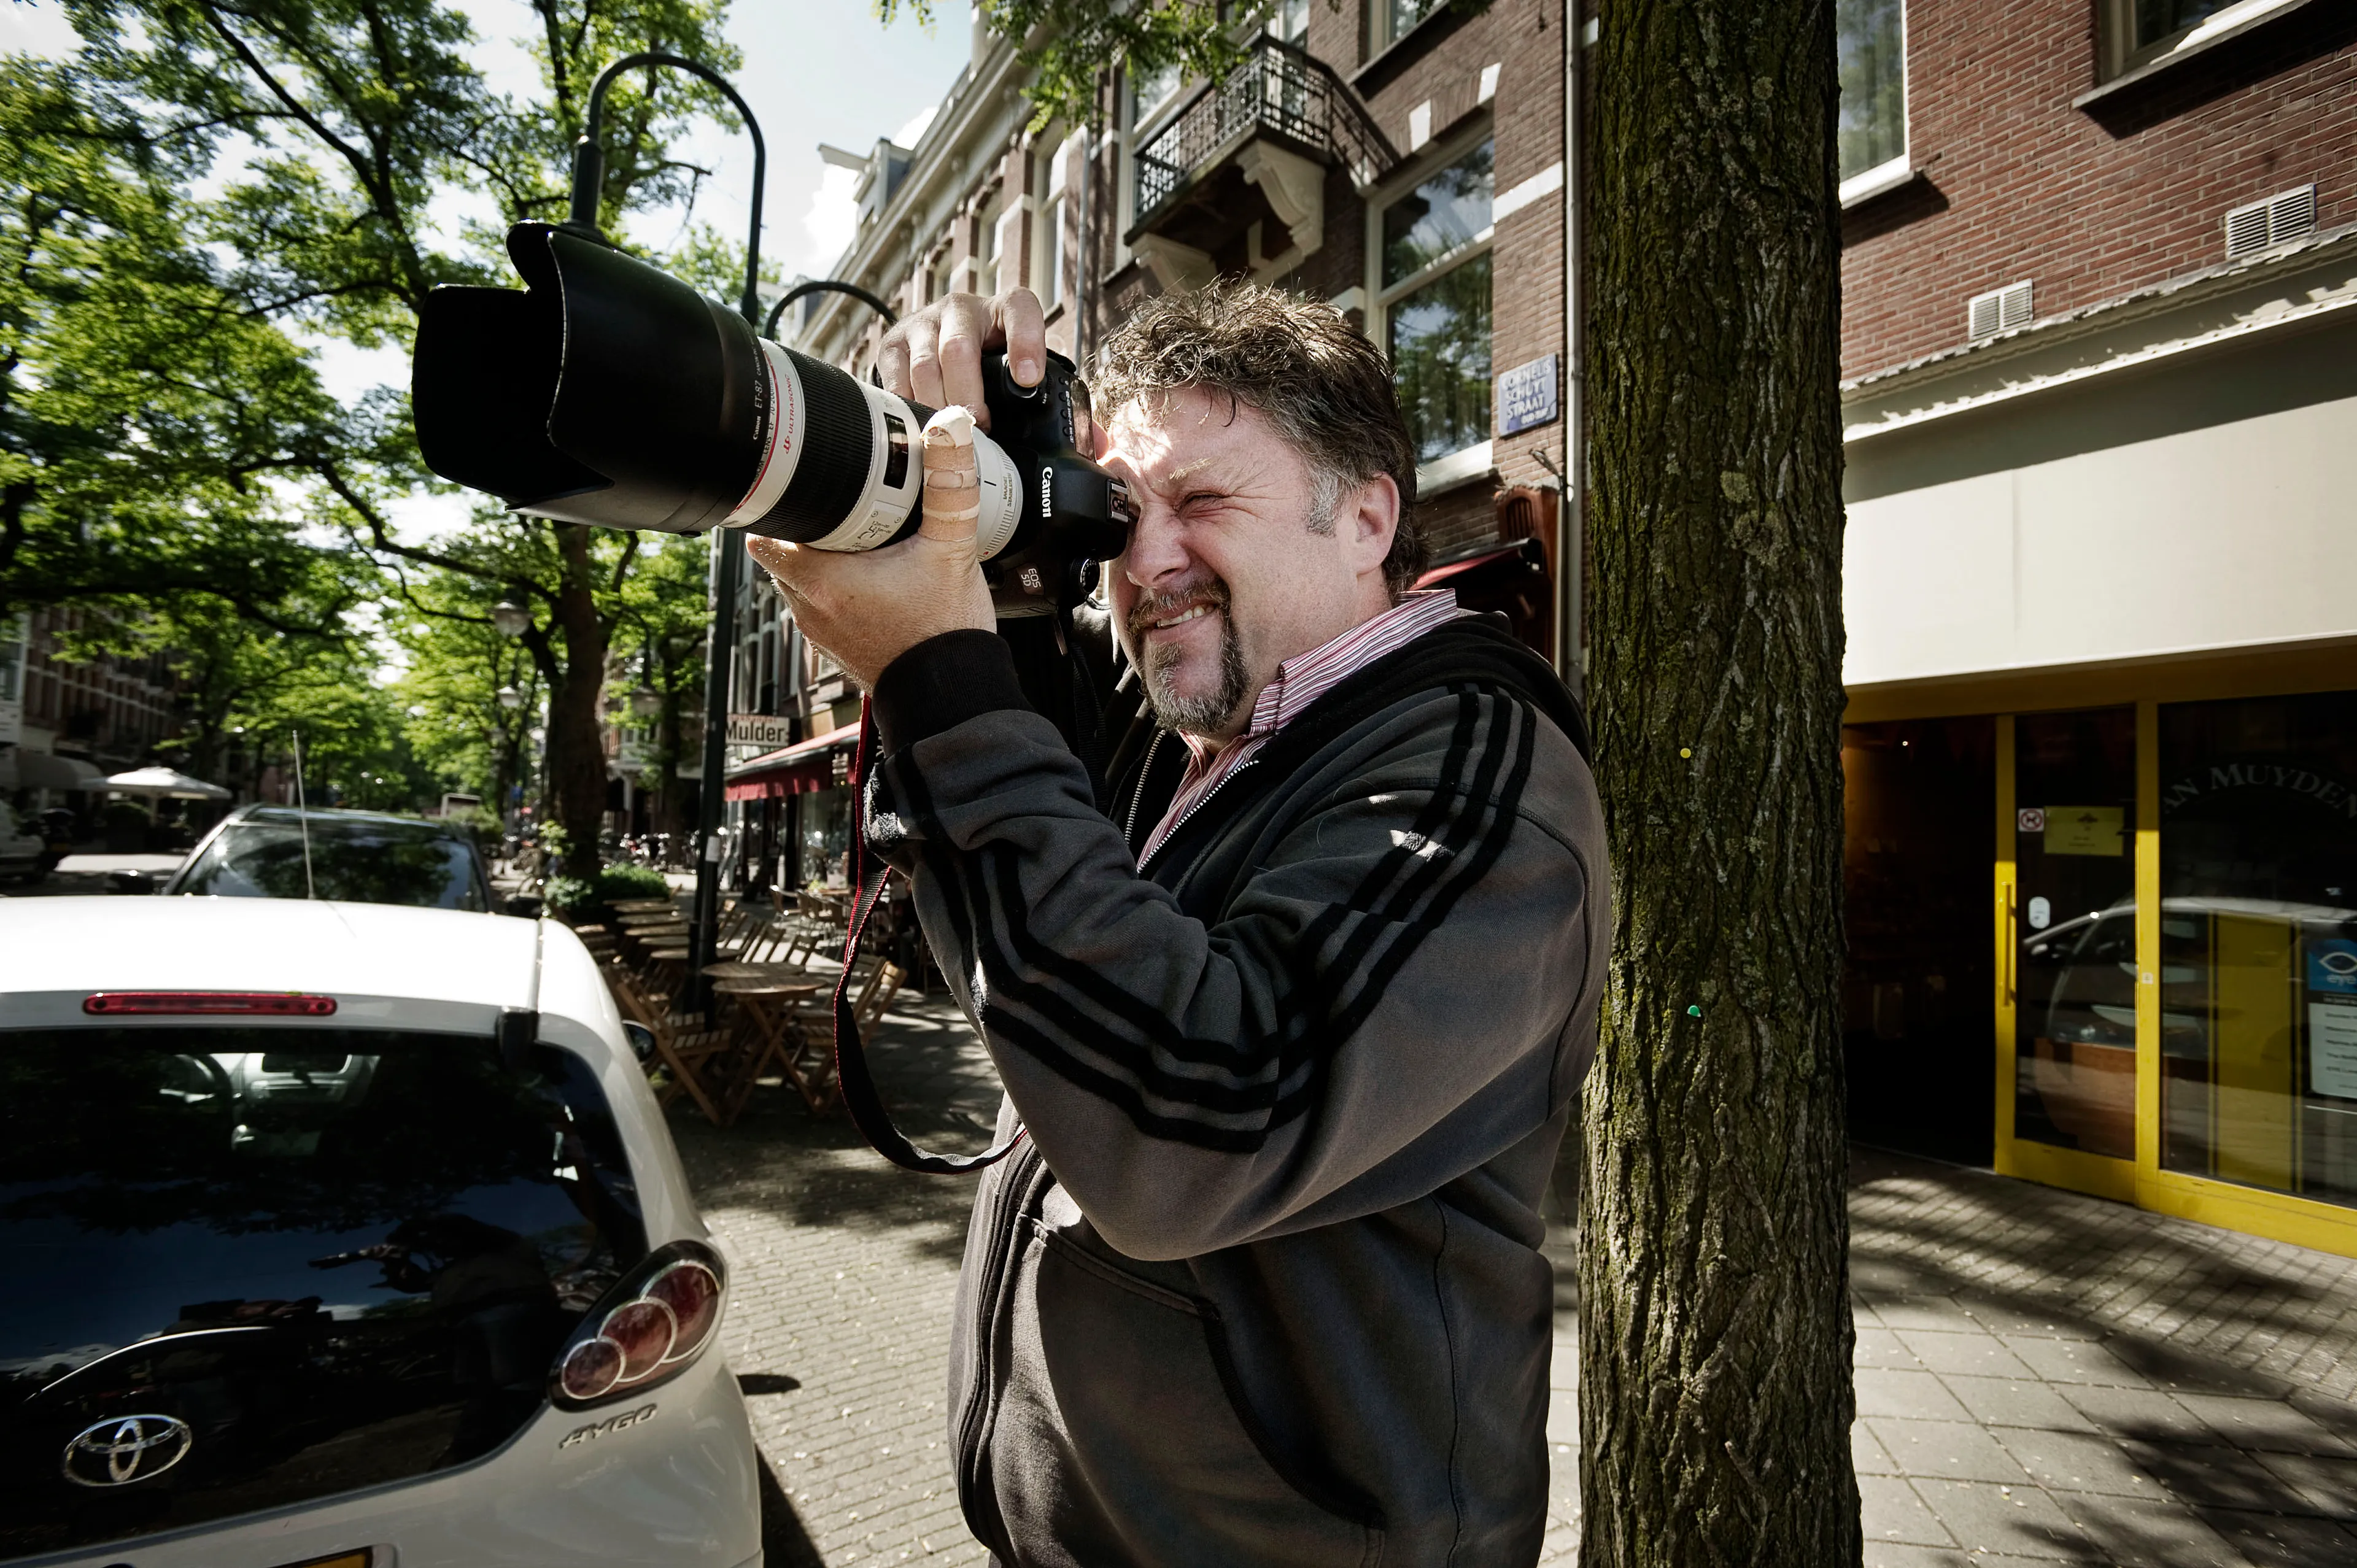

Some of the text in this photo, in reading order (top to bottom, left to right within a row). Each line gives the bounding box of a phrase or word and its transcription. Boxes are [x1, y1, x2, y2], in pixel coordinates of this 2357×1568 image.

[1502, 359, 1552, 390] CORNELIS
[785, 373, 795, 434] ULTRASONIC
[1505, 377, 1547, 404] SCHUYT
[1507, 394, 1545, 419] STRAAT
[753, 415, 761, 440] Canon
[763, 436, 772, 455] LENS
[1042, 466, 1053, 517] Canon
[1021, 574, 1032, 587] 5D
[1028, 568, 1042, 588] EOS
[726, 720, 784, 743] Mulder
[2162, 777, 2201, 814] AN
[559, 1402, 658, 1449] AYGO
